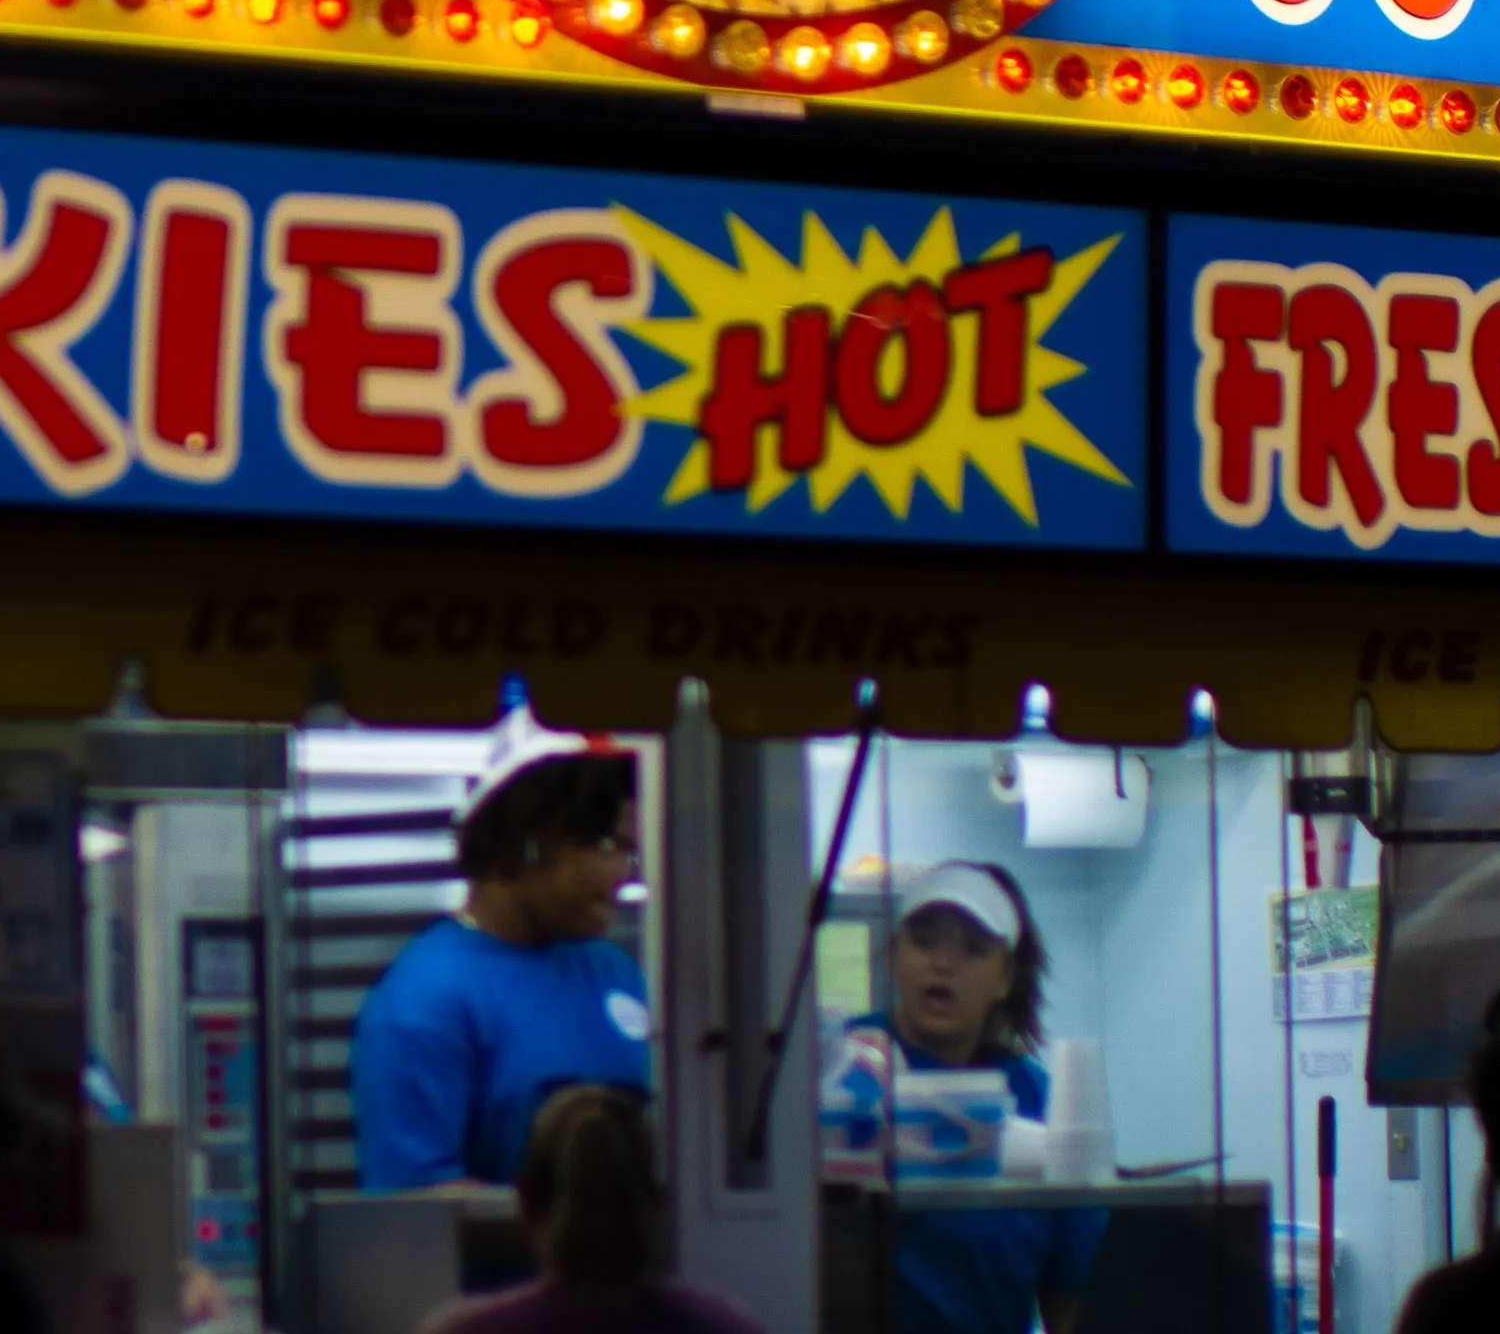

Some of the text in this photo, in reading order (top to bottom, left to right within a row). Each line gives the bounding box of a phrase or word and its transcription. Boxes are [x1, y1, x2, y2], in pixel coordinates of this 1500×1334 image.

[693, 246, 1054, 490] HOT
[185, 592, 988, 669] ICE COLD DRINKS
[1357, 629, 1484, 684] ICE
